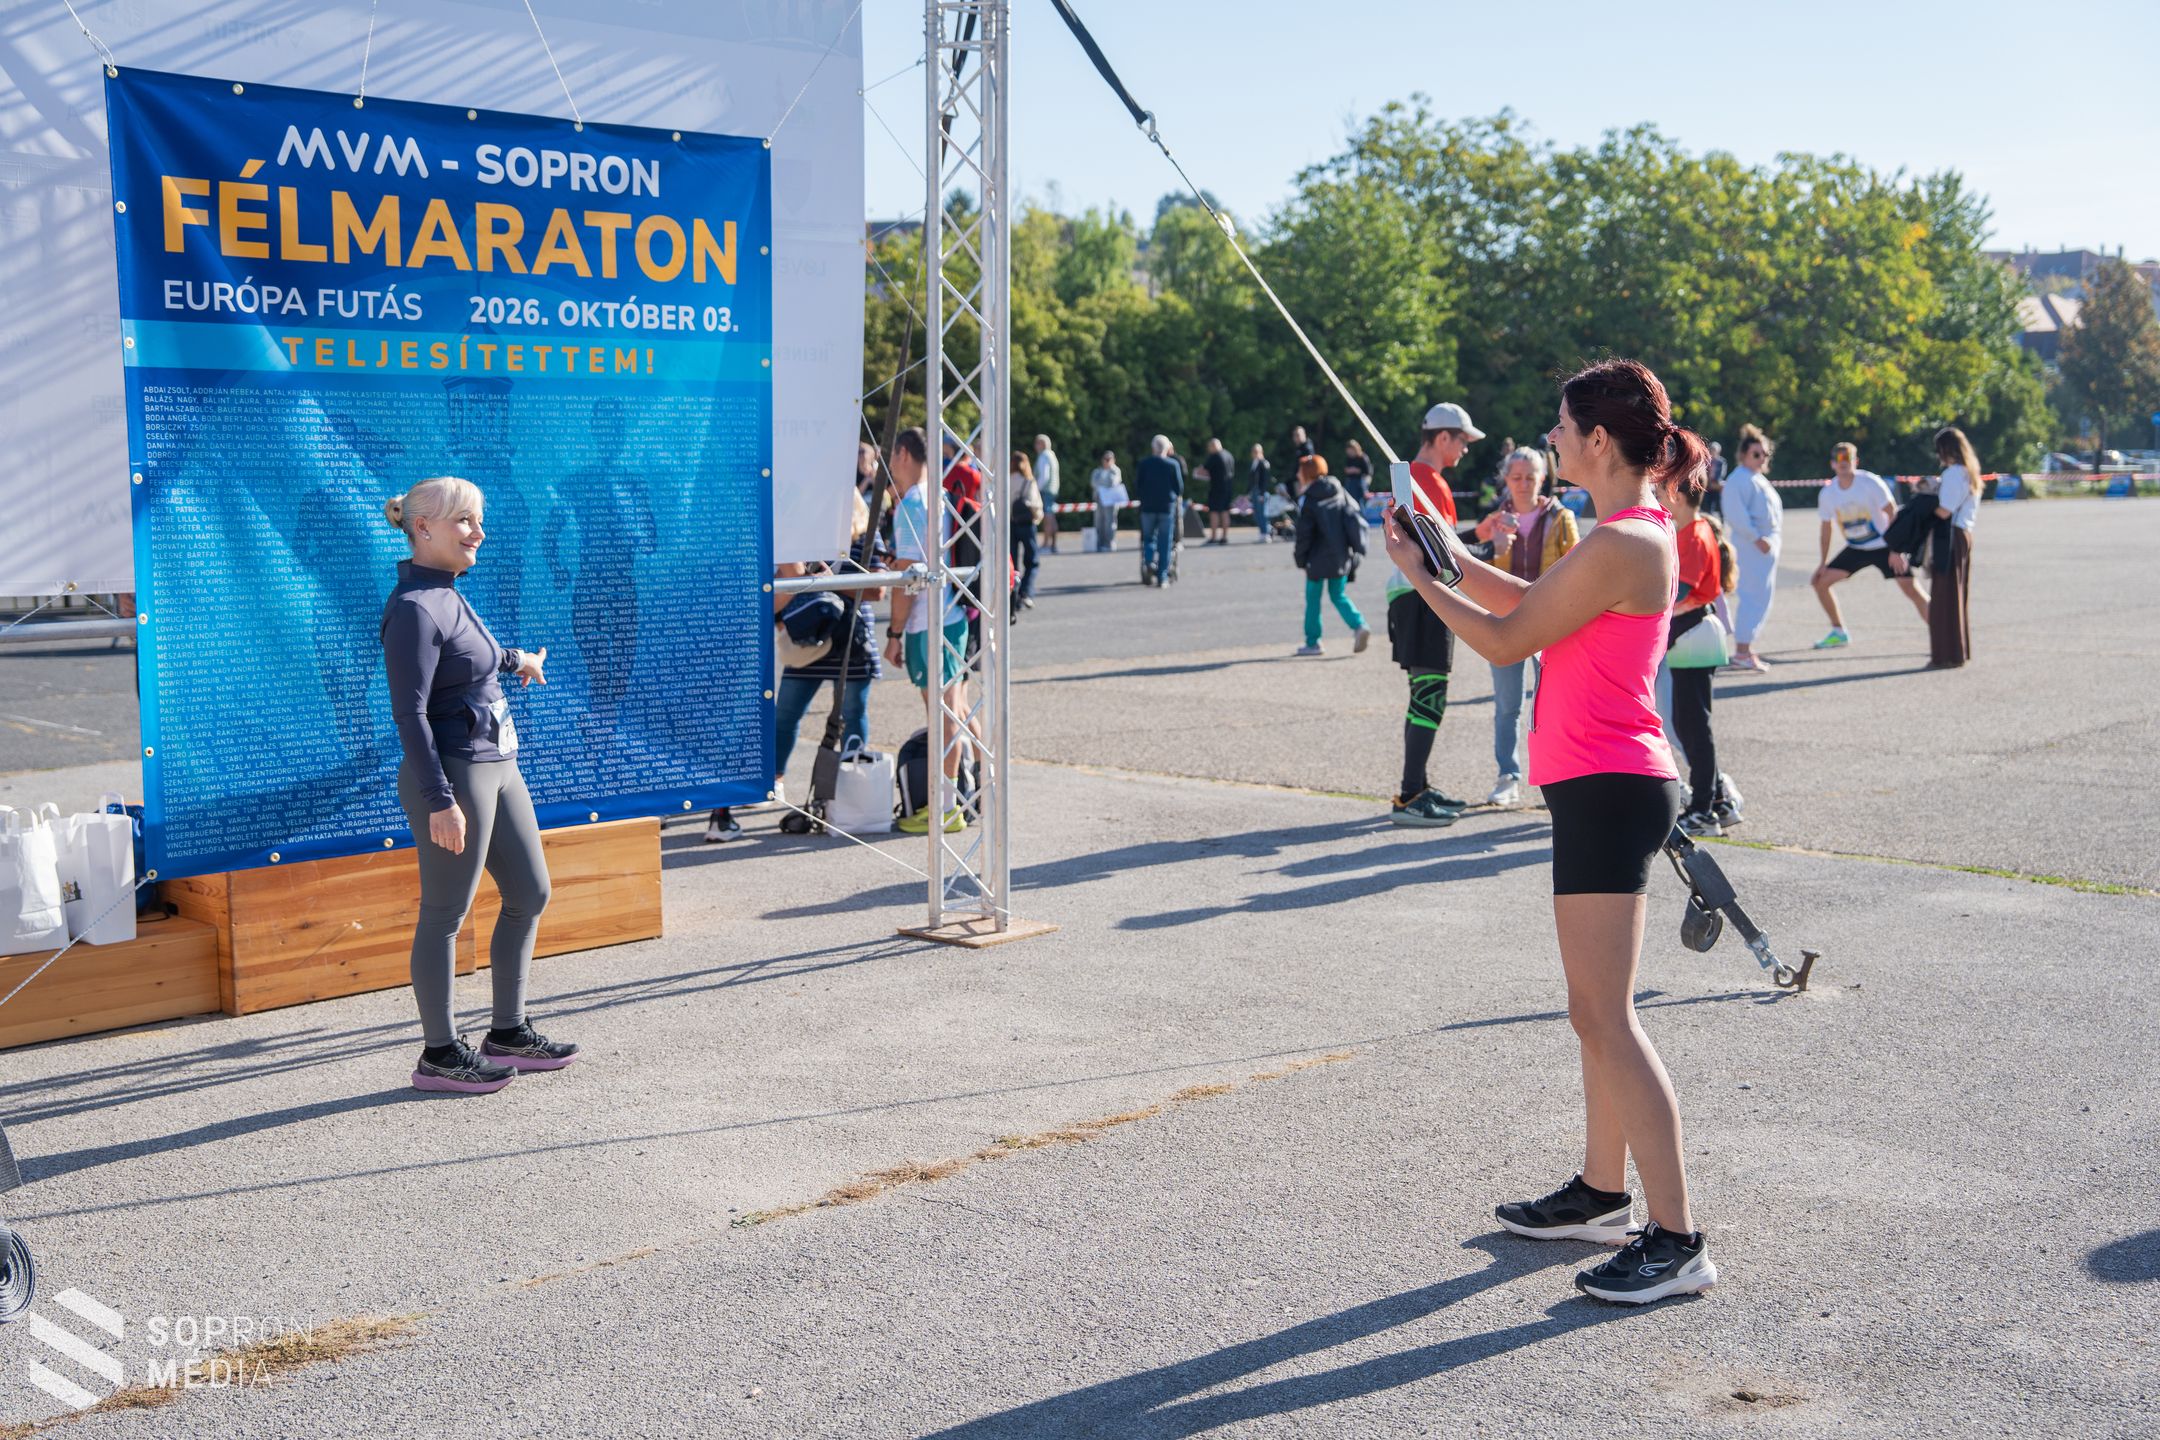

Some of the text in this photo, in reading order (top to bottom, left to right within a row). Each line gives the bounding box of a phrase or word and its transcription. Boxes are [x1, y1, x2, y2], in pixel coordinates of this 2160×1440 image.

[277, 125, 660, 198] MVM - SOPRON
[161, 160, 738, 285] FÉLMARATON
[164, 277, 422, 320] EURÓPA FUTÁS
[470, 296, 739, 332] 2026. OKTÓBER 03.
[282, 336, 656, 374] TELJESÍTETTEM!
